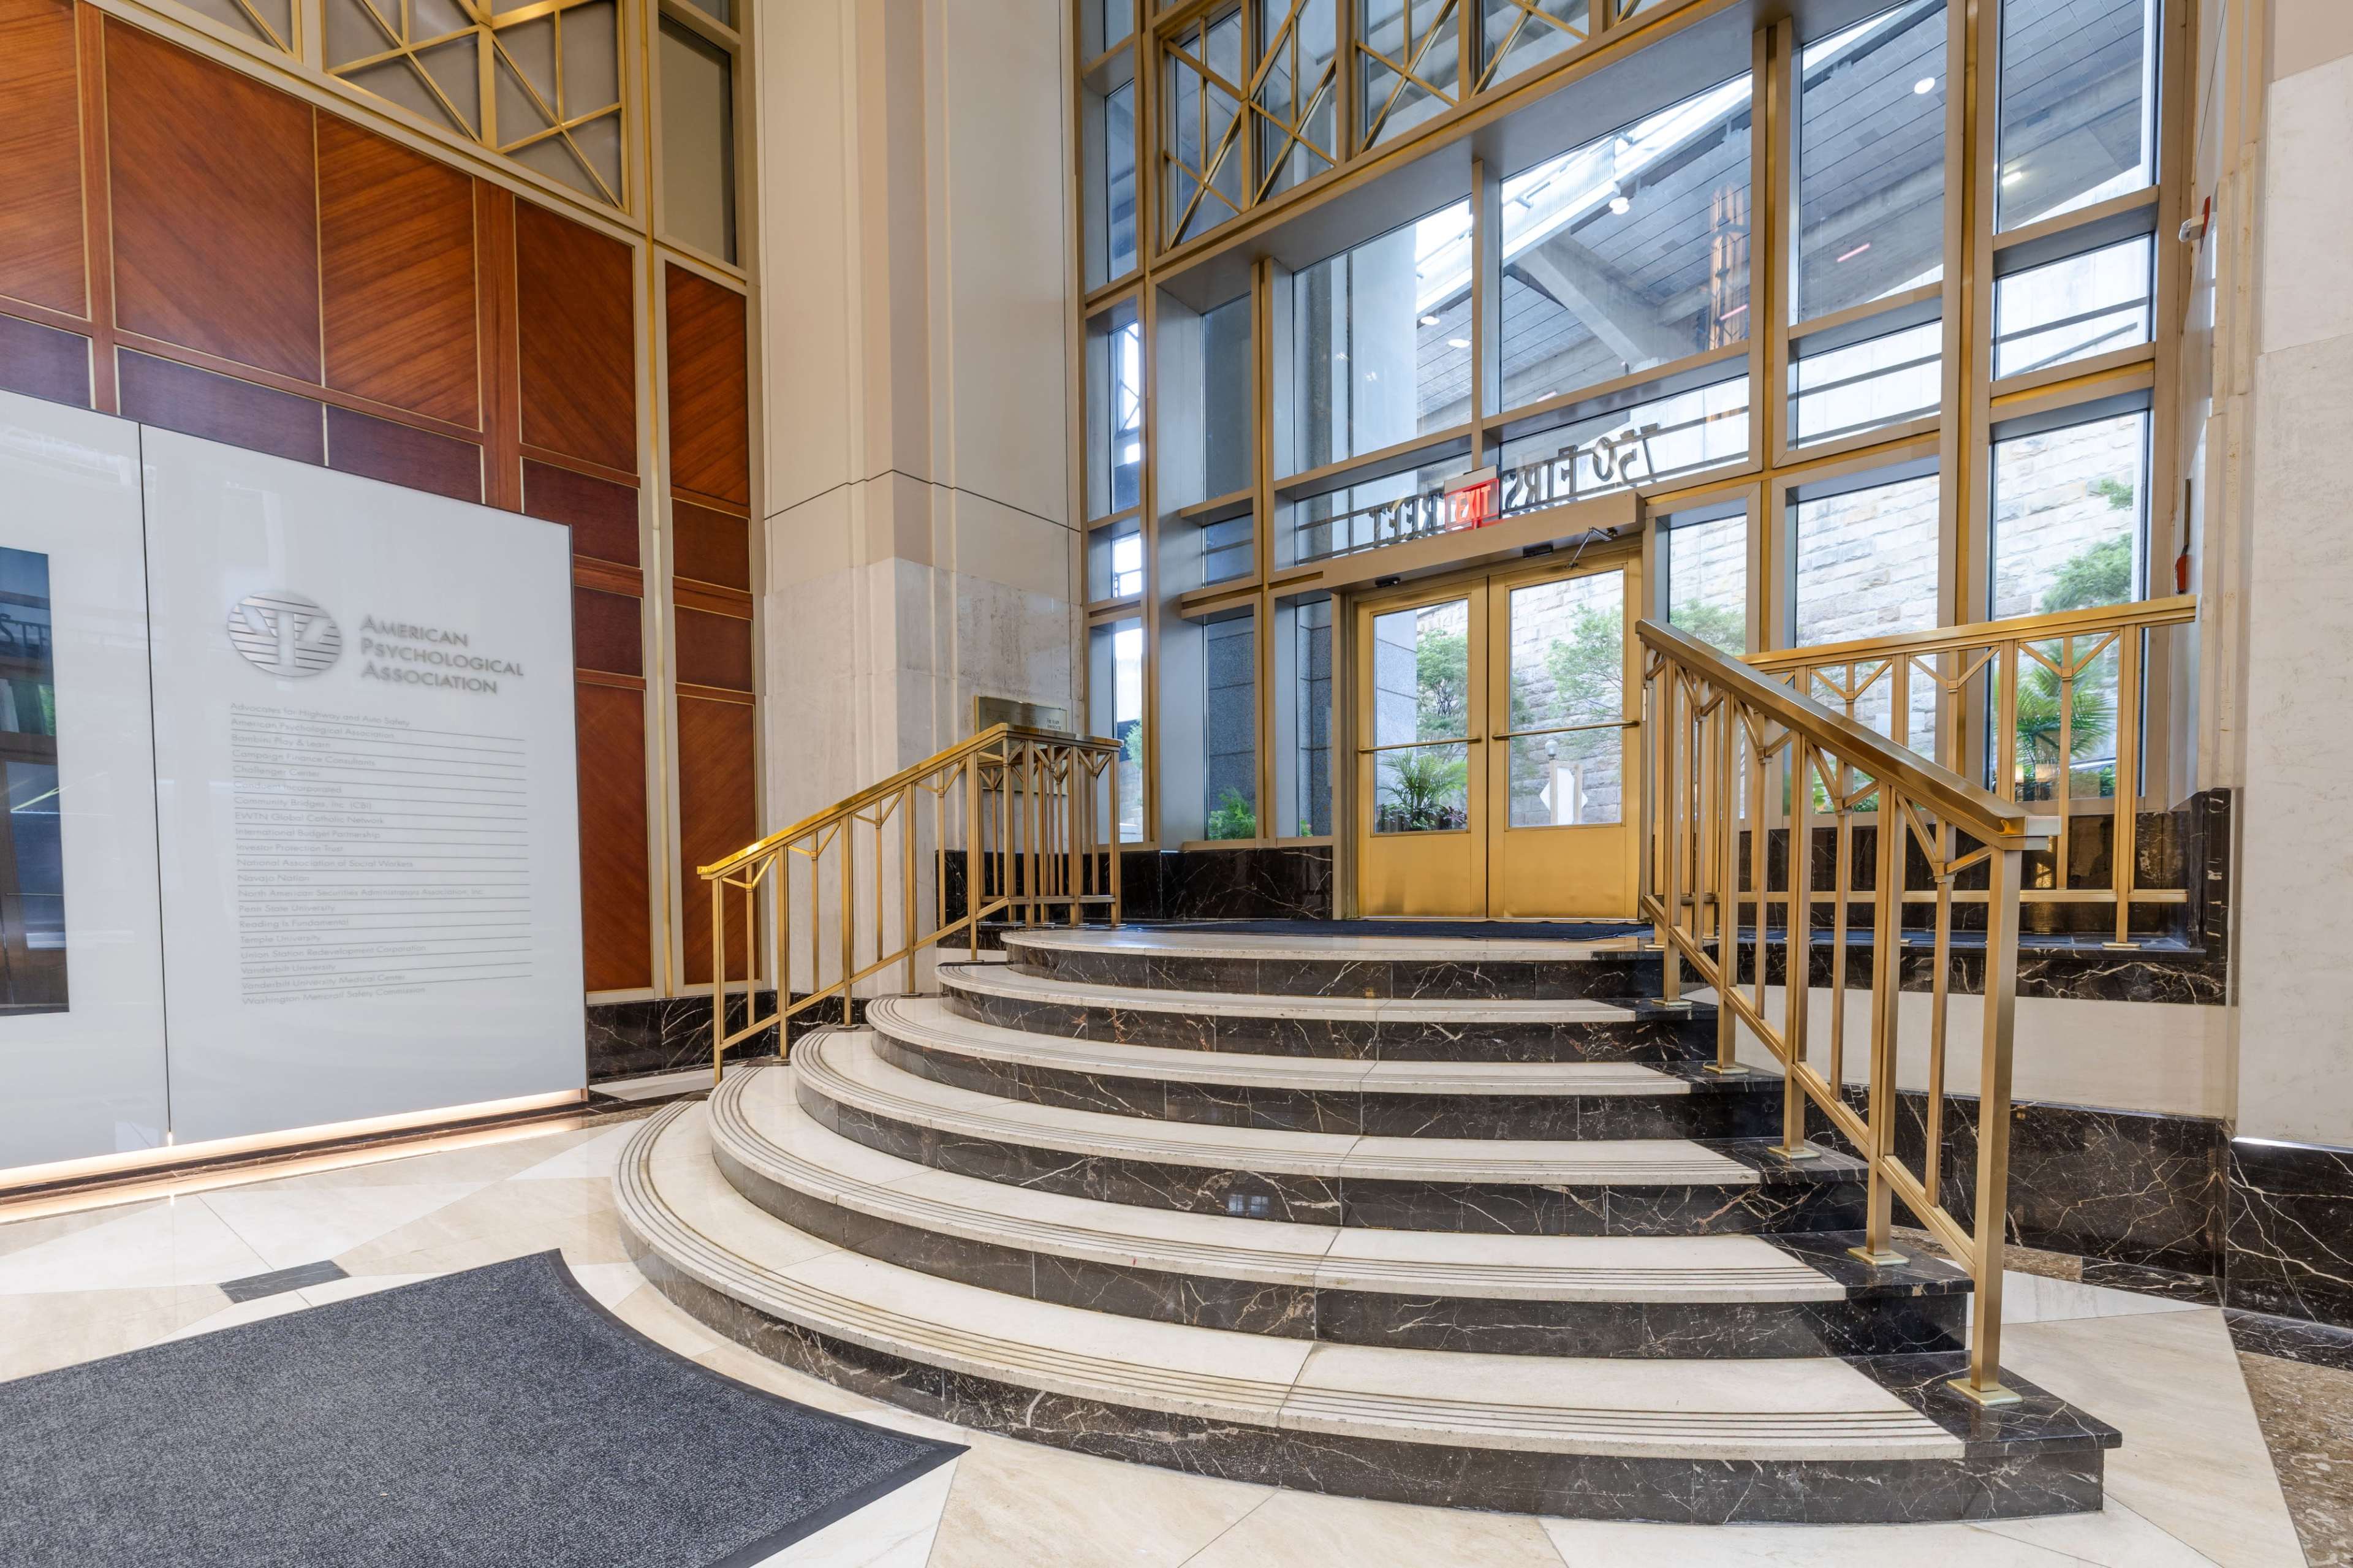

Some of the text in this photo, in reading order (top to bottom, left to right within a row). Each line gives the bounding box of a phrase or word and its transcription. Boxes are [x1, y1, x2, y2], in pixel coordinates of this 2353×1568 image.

[1455, 485, 1491, 523] EXIT
[359, 614, 469, 646] AMERICAN
[361, 637, 524, 676] PSYCHOLOGICAL
[362, 661, 498, 694] ASSOCIATION
[230, 703, 410, 727] Advocates for Highway and Auto Safety
[231, 718, 394, 738] American Psychological Association
[232, 734, 270, 743] Bambini
[274, 737, 293, 746] Play
[306, 740, 330, 748] Learn
[232, 749, 376, 766] Campaign Finance Consultants
[233, 765, 319, 777] Challenger Center
[283, 783, 341, 794] Incorporated
[233, 796, 287, 808] Community
[235, 811, 384, 824] EWTN Global Catholic Network
[235, 828, 381, 840] International Budget Partnership
[237, 843, 273, 851] Investor
[276, 843, 320, 852] Protection
[237, 874, 275, 883] Navajo
[238, 889, 266, 898] North
[316, 888, 358, 897] Securities
[362, 888, 419, 896] Administrators
[265, 904, 289, 913] State
[291, 904, 335, 912] University
[240, 920, 279, 930] Reading
[292, 917, 349, 928] Fundamental
[240, 934, 321, 945] Temple University
[241, 951, 269, 960] Union
[307, 947, 374, 957] Redevelopment
[376, 945, 426, 954] Corporation
[241, 963, 336, 975] Vanderbilt University
[241, 973, 405, 990] Vanderbilt University Medical Center
[242, 986, 426, 1006] Washington Metrorail Safety Commission
